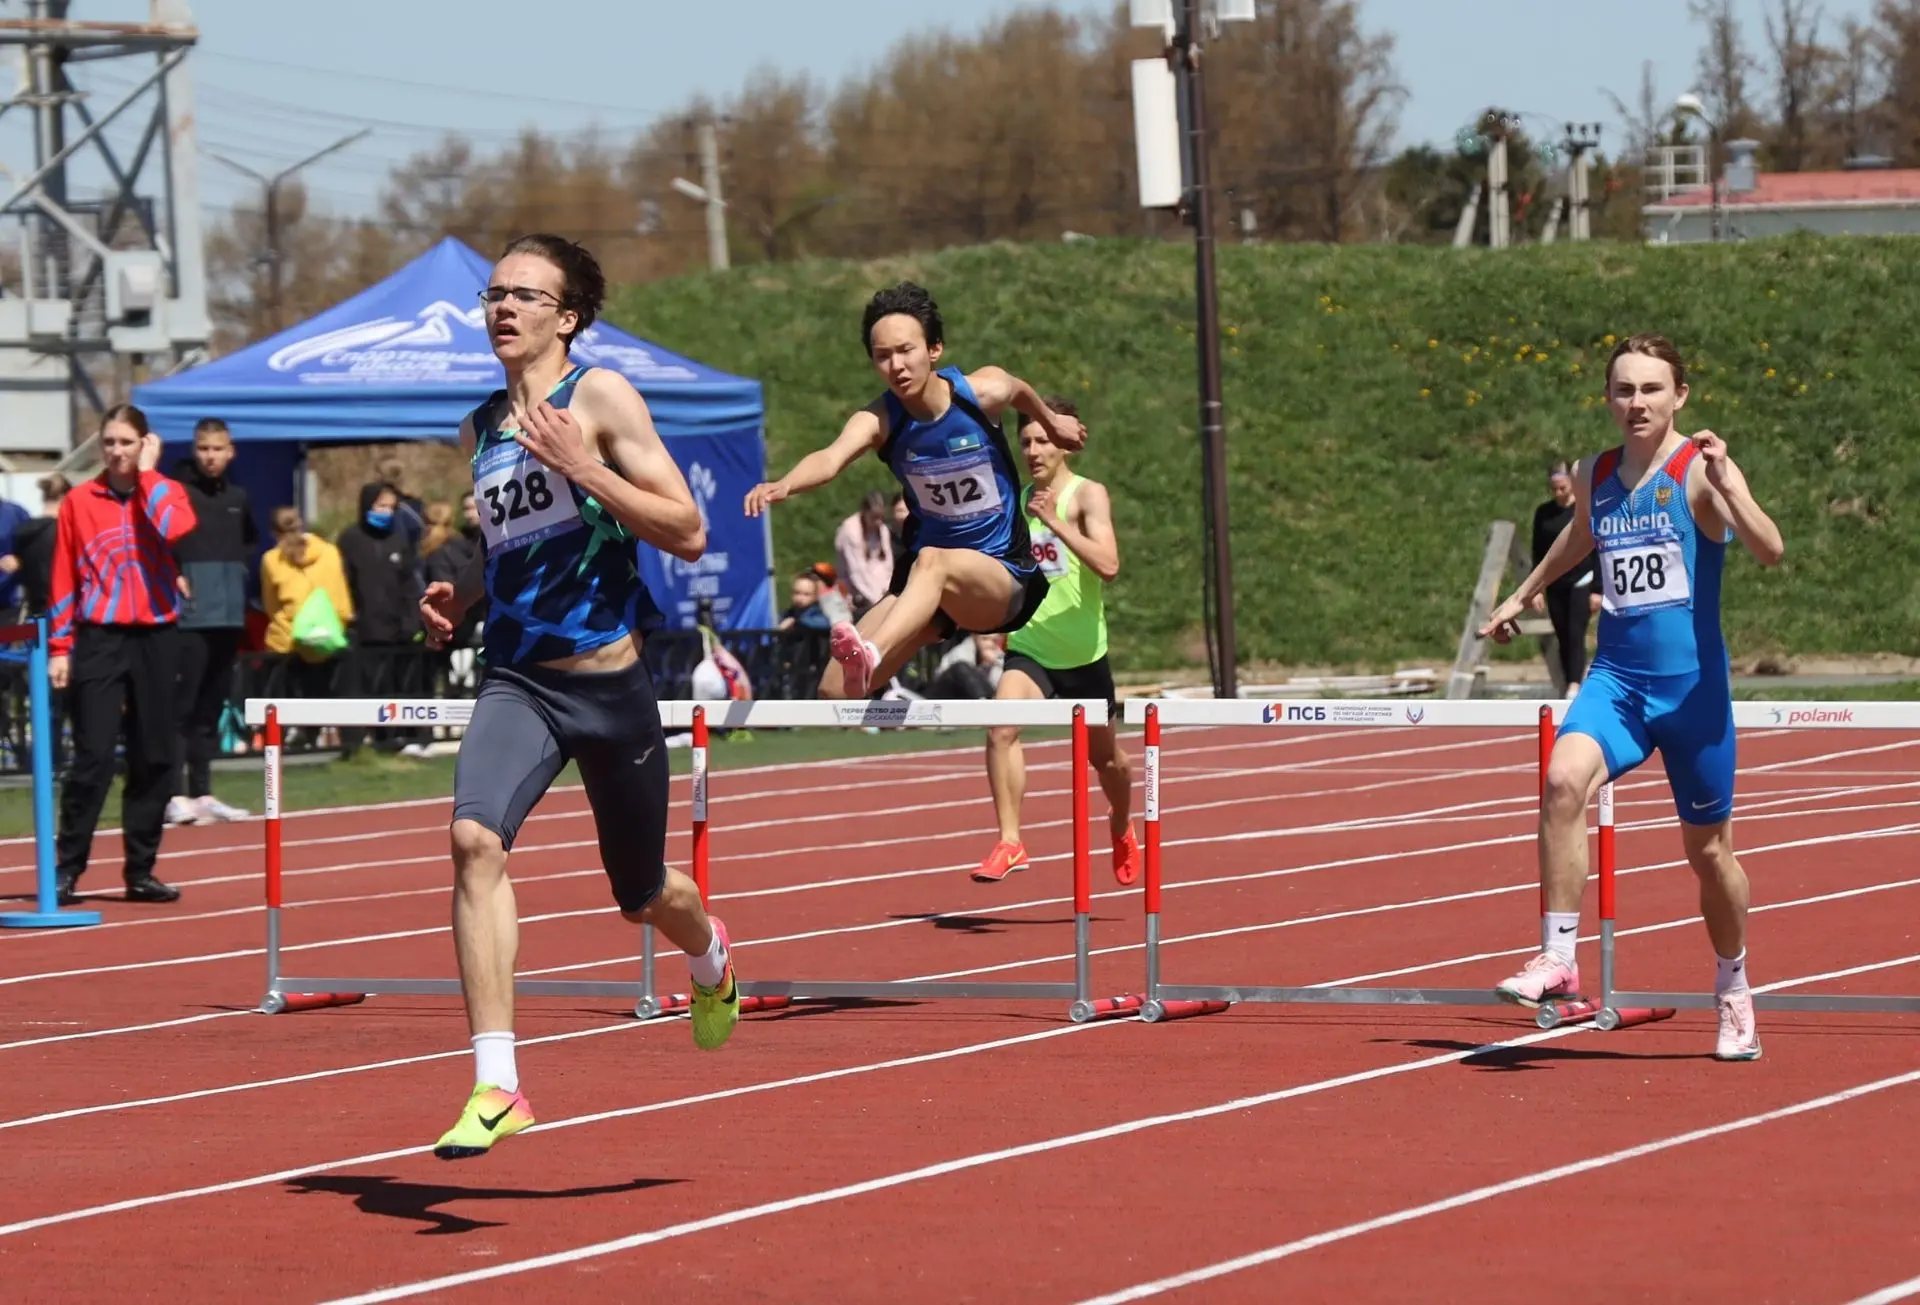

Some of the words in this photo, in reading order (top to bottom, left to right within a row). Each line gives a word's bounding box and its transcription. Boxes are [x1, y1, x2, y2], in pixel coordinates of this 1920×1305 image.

[484, 471, 553, 526] 328
[925, 478, 982, 506] 312
[1613, 553, 1666, 596] 528
[402, 706, 438, 719] ПСБ
[1288, 706, 1326, 720] ПСБ
[1788, 708, 1854, 725] polanik
[1600, 783, 1610, 807] pola
